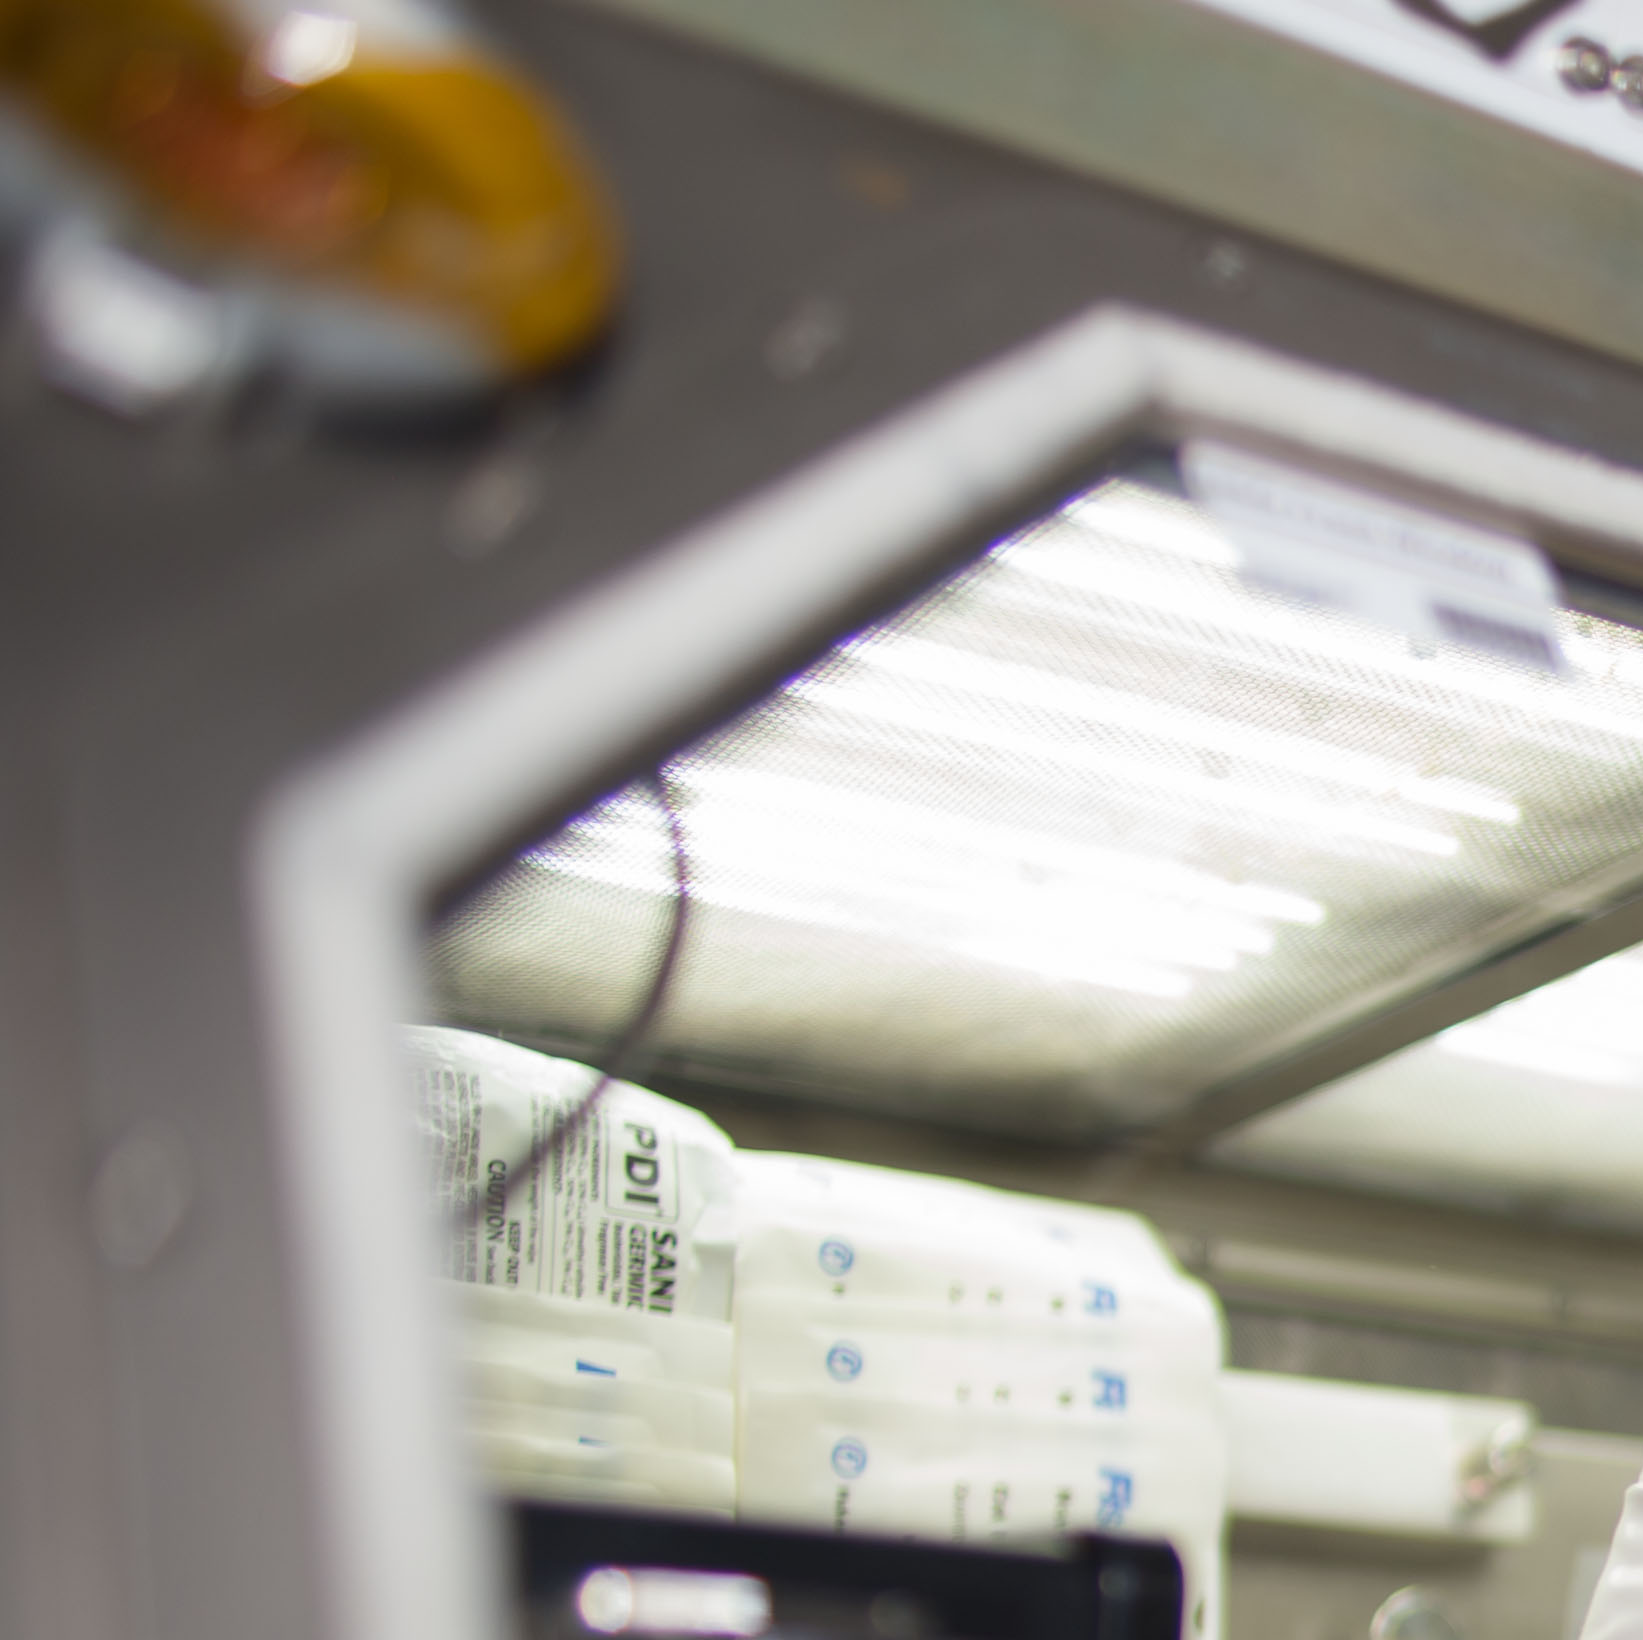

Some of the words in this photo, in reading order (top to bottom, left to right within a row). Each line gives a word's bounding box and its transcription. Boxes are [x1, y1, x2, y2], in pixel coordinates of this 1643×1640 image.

[485, 1158, 507, 1243] CAUTION
[624, 1121, 662, 1206] PDI
[648, 1229, 679, 1318] SANI
